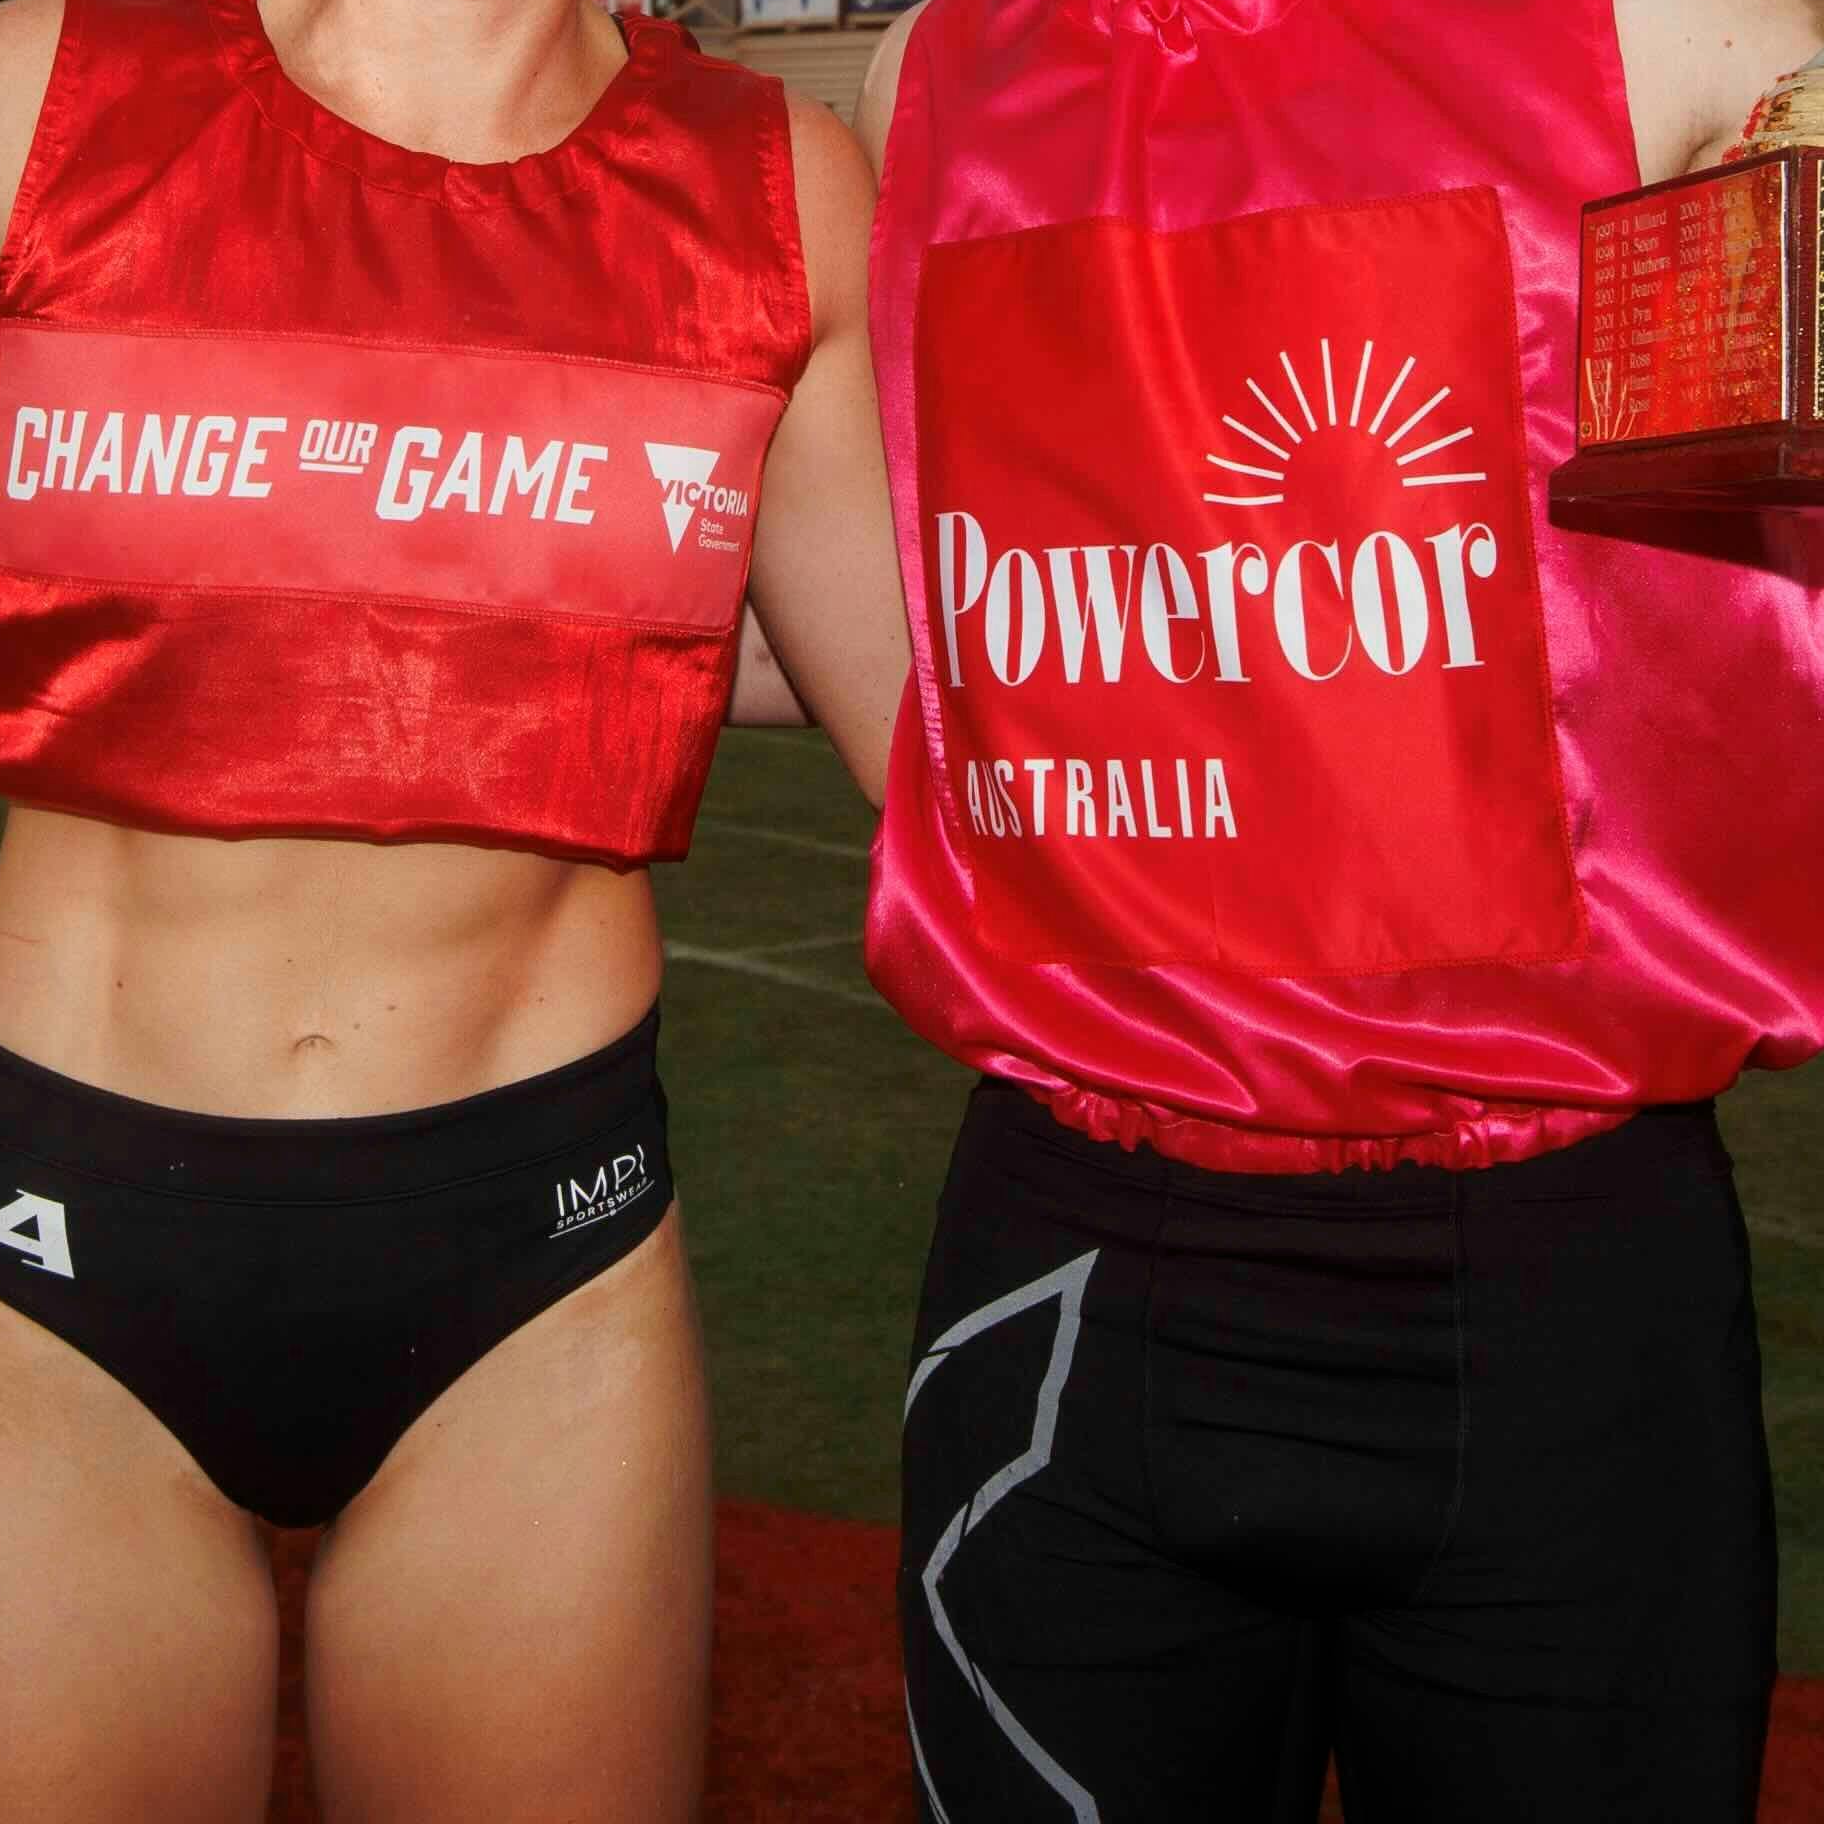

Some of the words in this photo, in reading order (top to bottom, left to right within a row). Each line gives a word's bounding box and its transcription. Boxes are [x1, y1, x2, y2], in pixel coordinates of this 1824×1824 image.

[6, 407, 287, 501] CHANGE
[299, 419, 378, 466] OUR
[376, 425, 608, 525] GAME
[660, 480, 749, 517] VICTORIA
[699, 517, 725, 536] State
[935, 511, 1498, 689] Powercor
[968, 758, 1238, 839] AUSTRALIA
